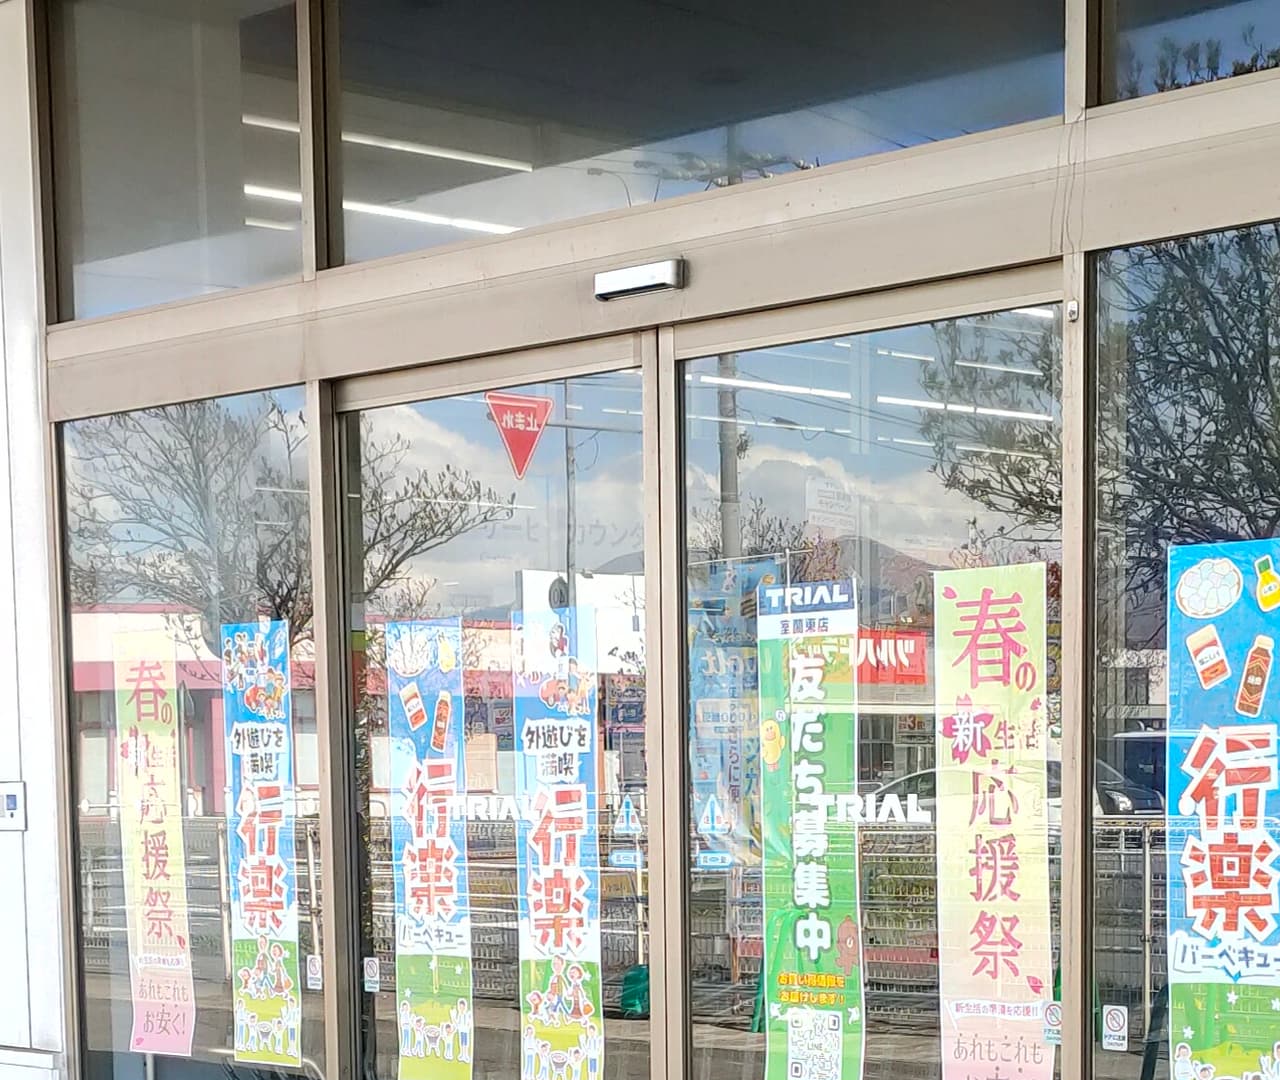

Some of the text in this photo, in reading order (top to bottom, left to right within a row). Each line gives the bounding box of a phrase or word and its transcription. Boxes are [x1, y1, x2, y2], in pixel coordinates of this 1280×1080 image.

[766, 584, 849, 608] TRIAL
[951, 587, 1037, 692] 春の
[525, 722, 589, 750] 外遊びを
[815, 792, 932, 822] TRIAL
[1182, 726, 1278, 933] 行楽
[530, 785, 586, 948] 行楽
[953, 1036, 1044, 1065] あれもこれも
